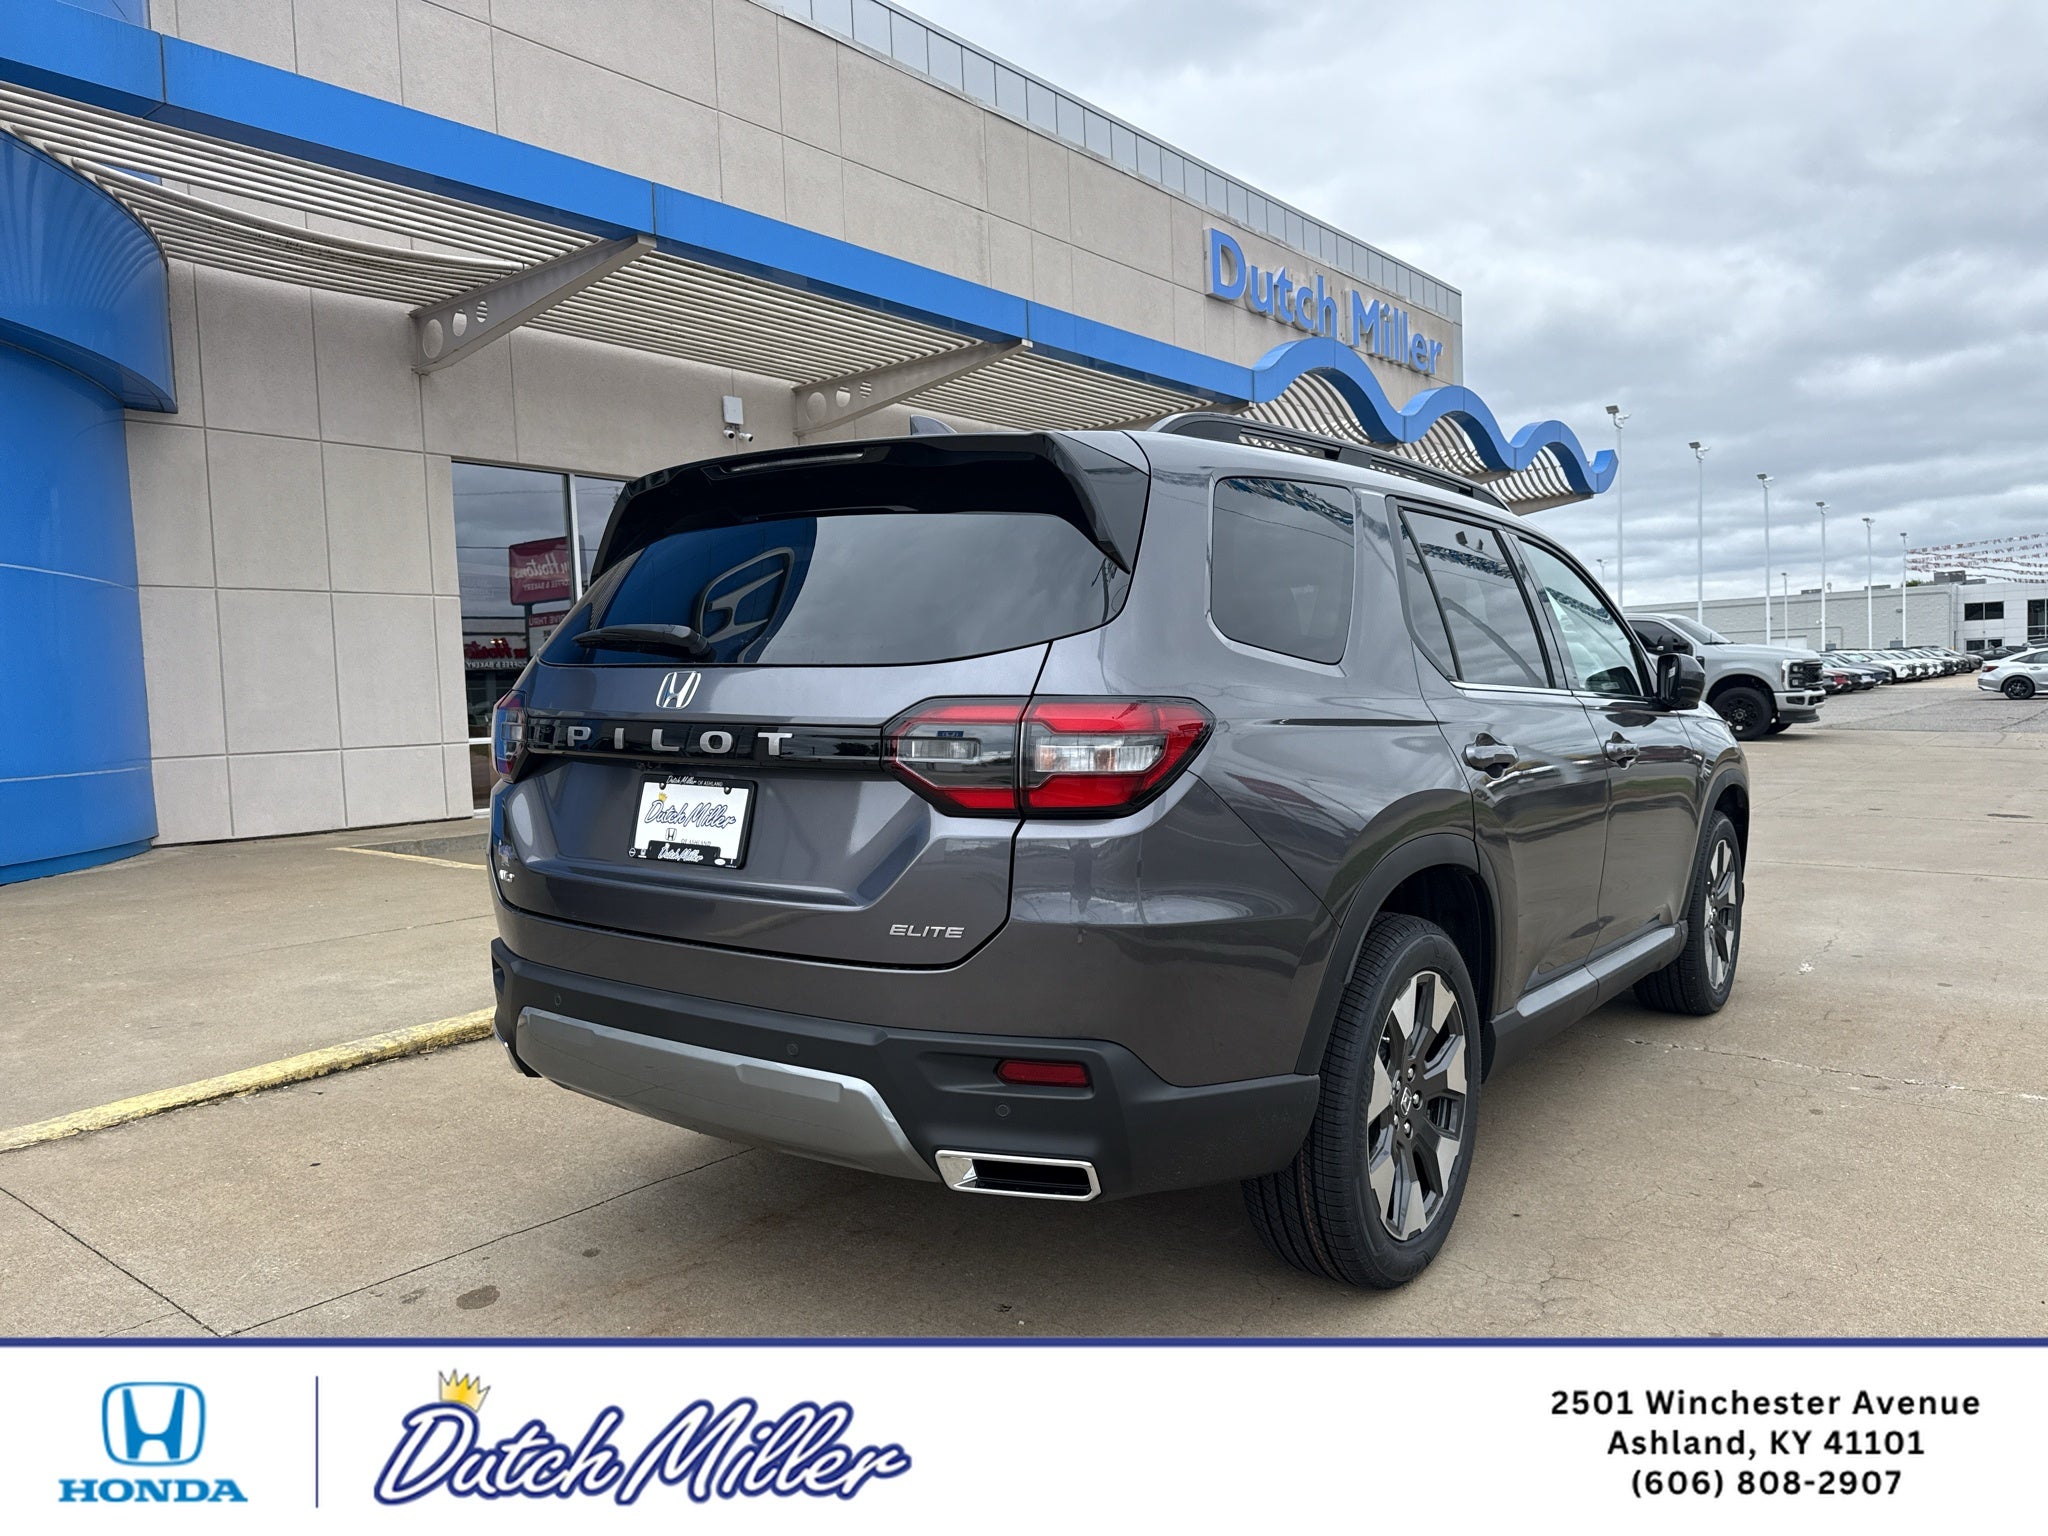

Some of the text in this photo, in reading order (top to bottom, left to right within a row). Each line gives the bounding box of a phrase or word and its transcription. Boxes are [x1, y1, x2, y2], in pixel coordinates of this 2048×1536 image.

[1206, 228, 1443, 375] Dutch Miller
[567, 726, 793, 756] PILOT
[644, 800, 737, 829] Dutch Miller
[889, 924, 965, 938] ELITE
